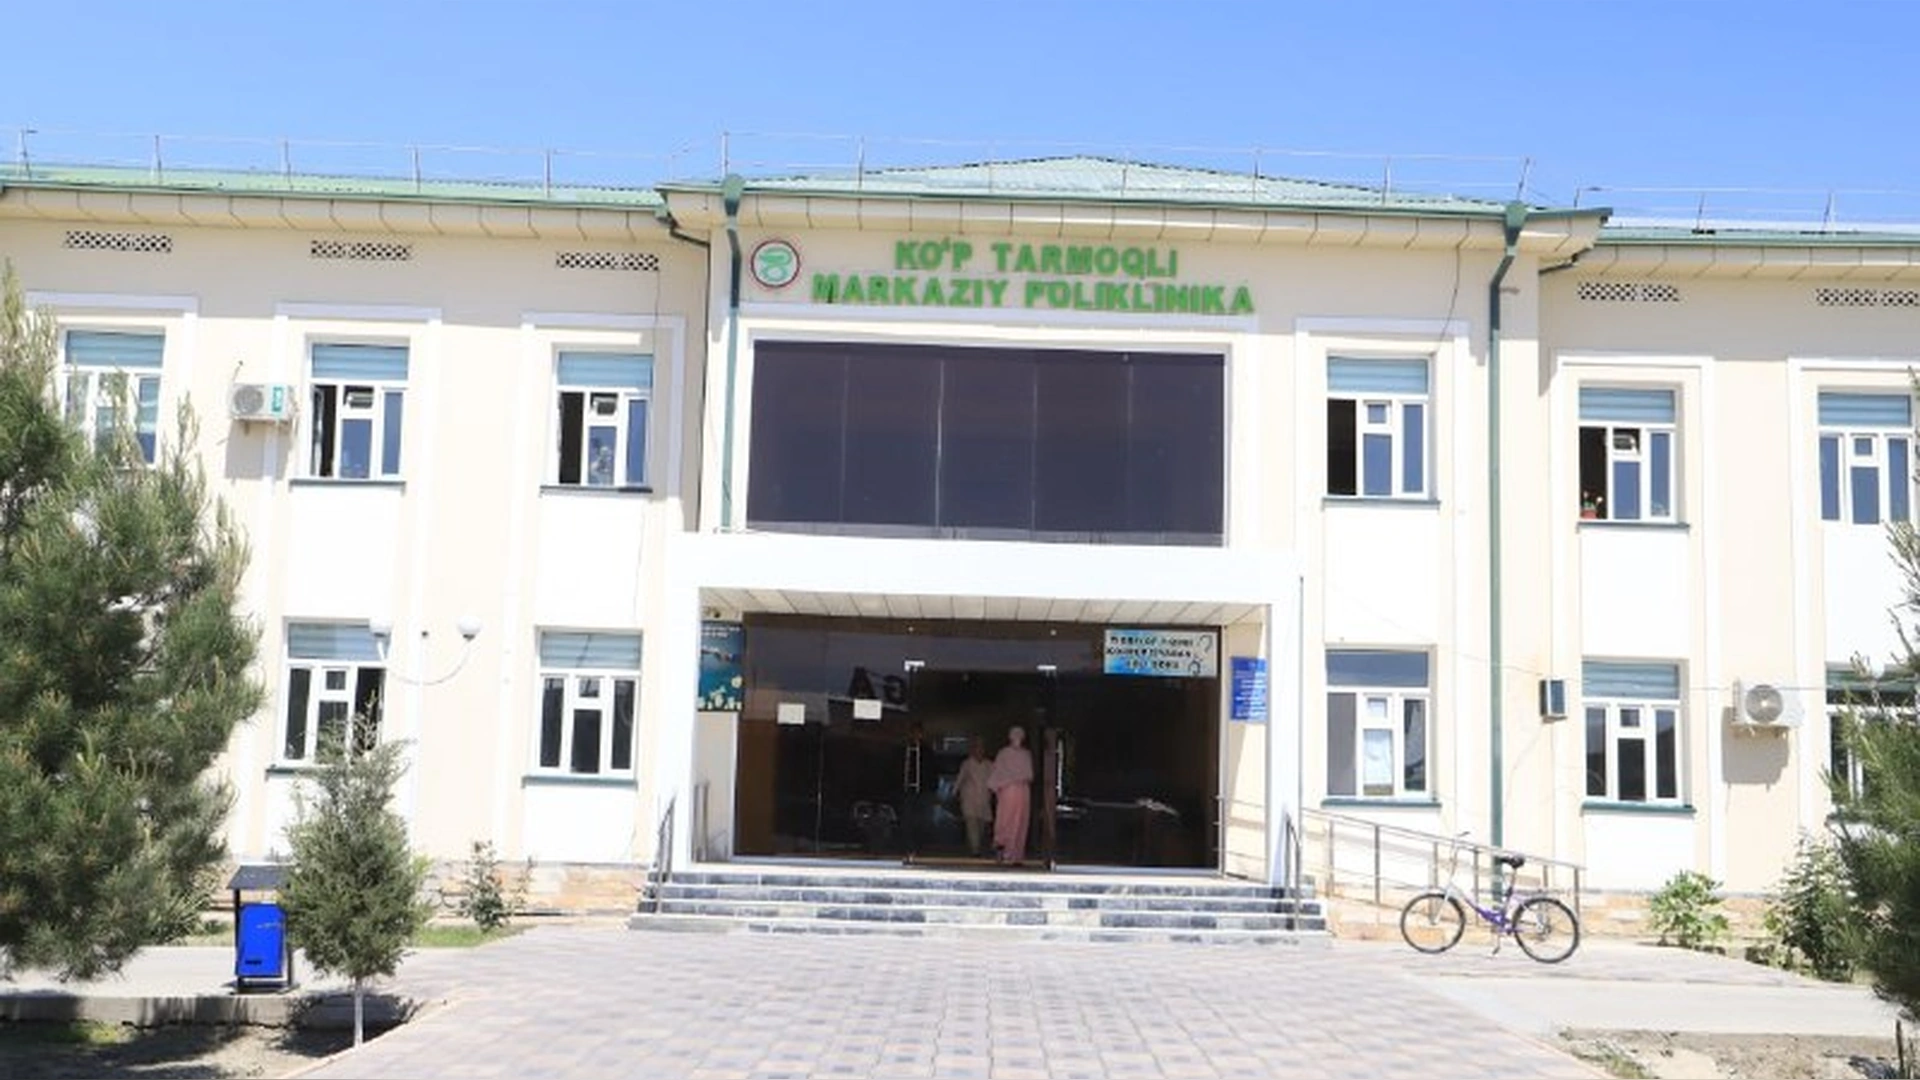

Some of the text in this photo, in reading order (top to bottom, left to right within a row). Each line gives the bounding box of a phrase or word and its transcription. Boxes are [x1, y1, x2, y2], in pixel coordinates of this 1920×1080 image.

[990, 242, 1178, 279] TARMOQLI
[812, 271, 1255, 315] MARKAZIY POLIKLINIKA
